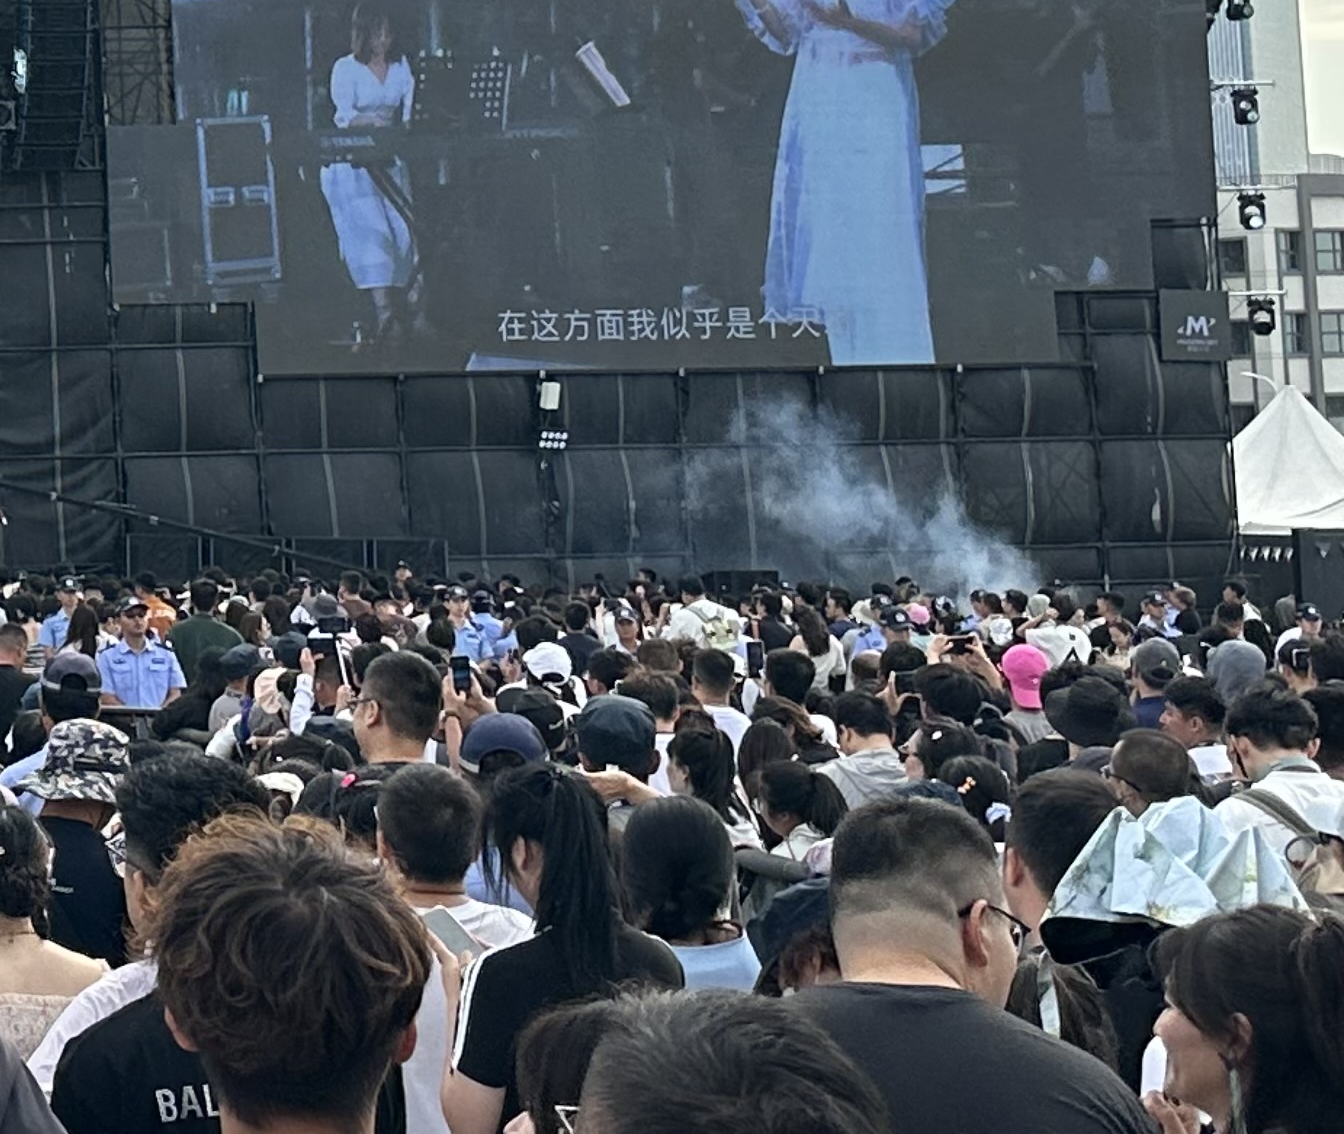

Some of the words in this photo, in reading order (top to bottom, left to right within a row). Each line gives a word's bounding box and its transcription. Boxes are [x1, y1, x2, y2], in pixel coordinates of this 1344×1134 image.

[497, 306, 830, 342] 在这方面我似乎是个天
[155, 1084, 220, 1123] BAL
